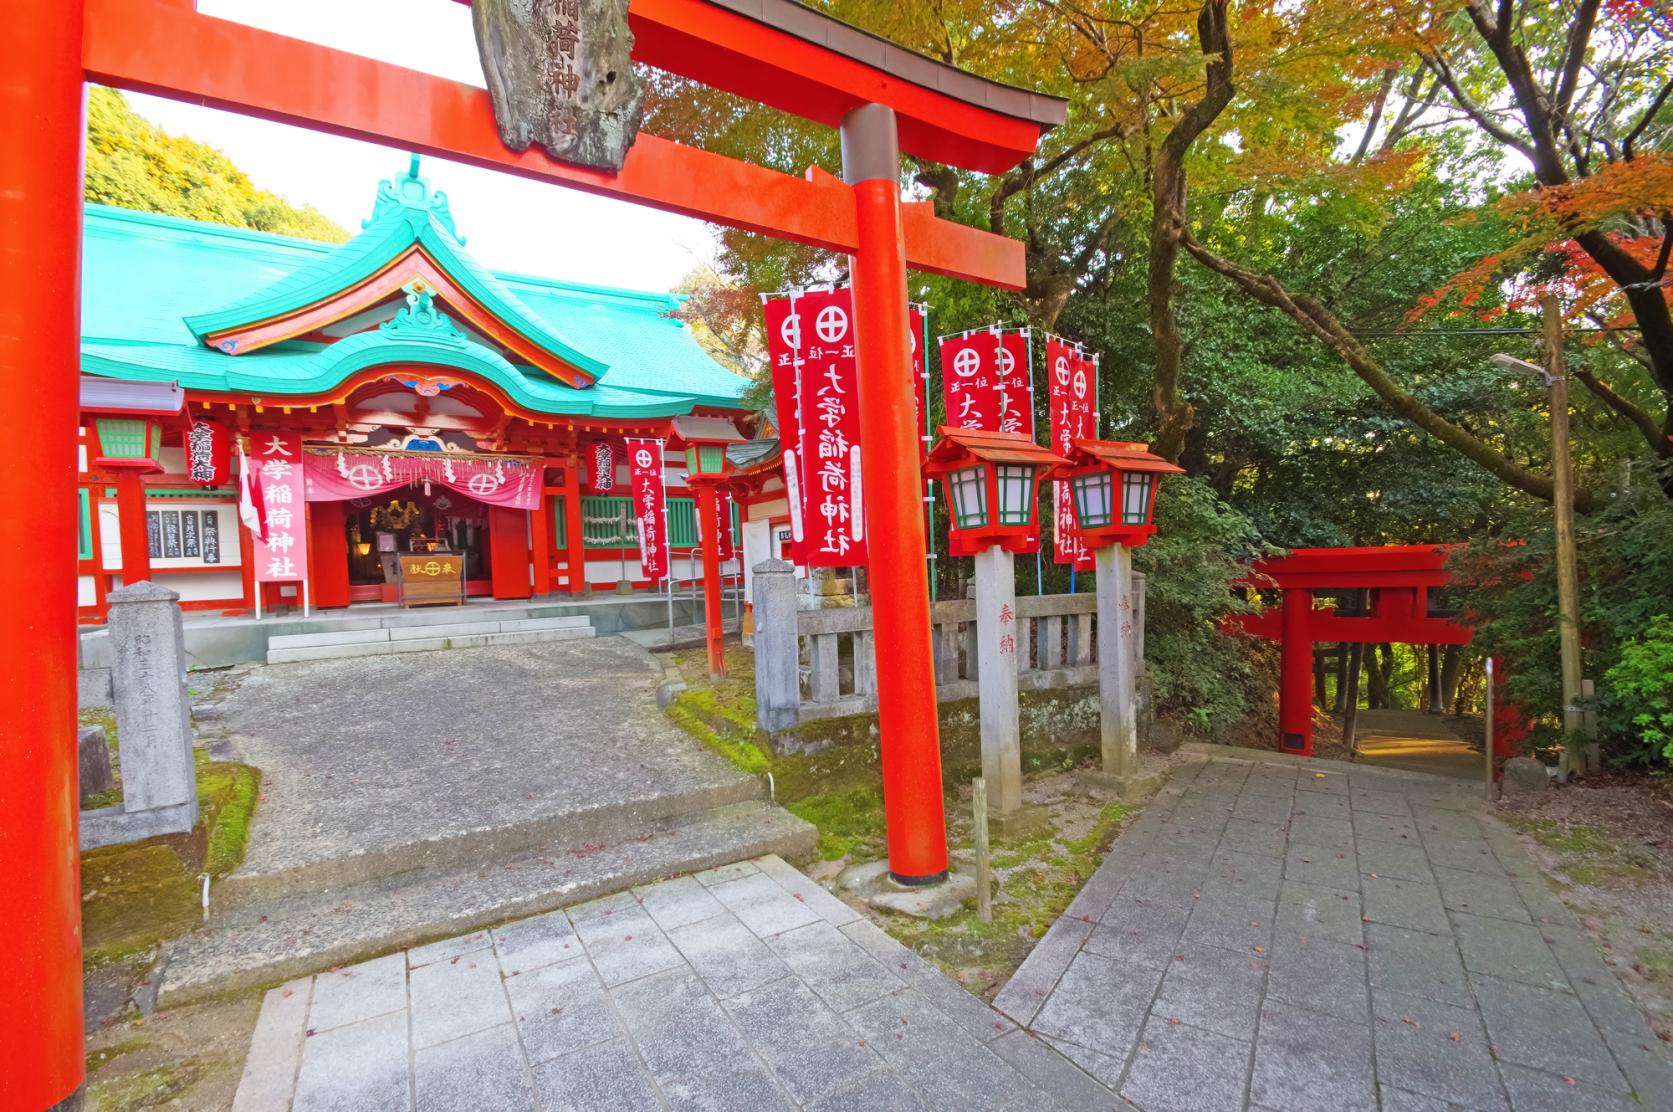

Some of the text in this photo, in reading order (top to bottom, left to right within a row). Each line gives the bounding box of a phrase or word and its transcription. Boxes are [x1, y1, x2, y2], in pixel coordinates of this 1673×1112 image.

[950, 376, 988, 393] 正一位
[262, 435, 297, 577] 大学稲荷神社
[641, 477, 659, 573] 大学稲荷神社
[999, 604, 1014, 655] 奉納
